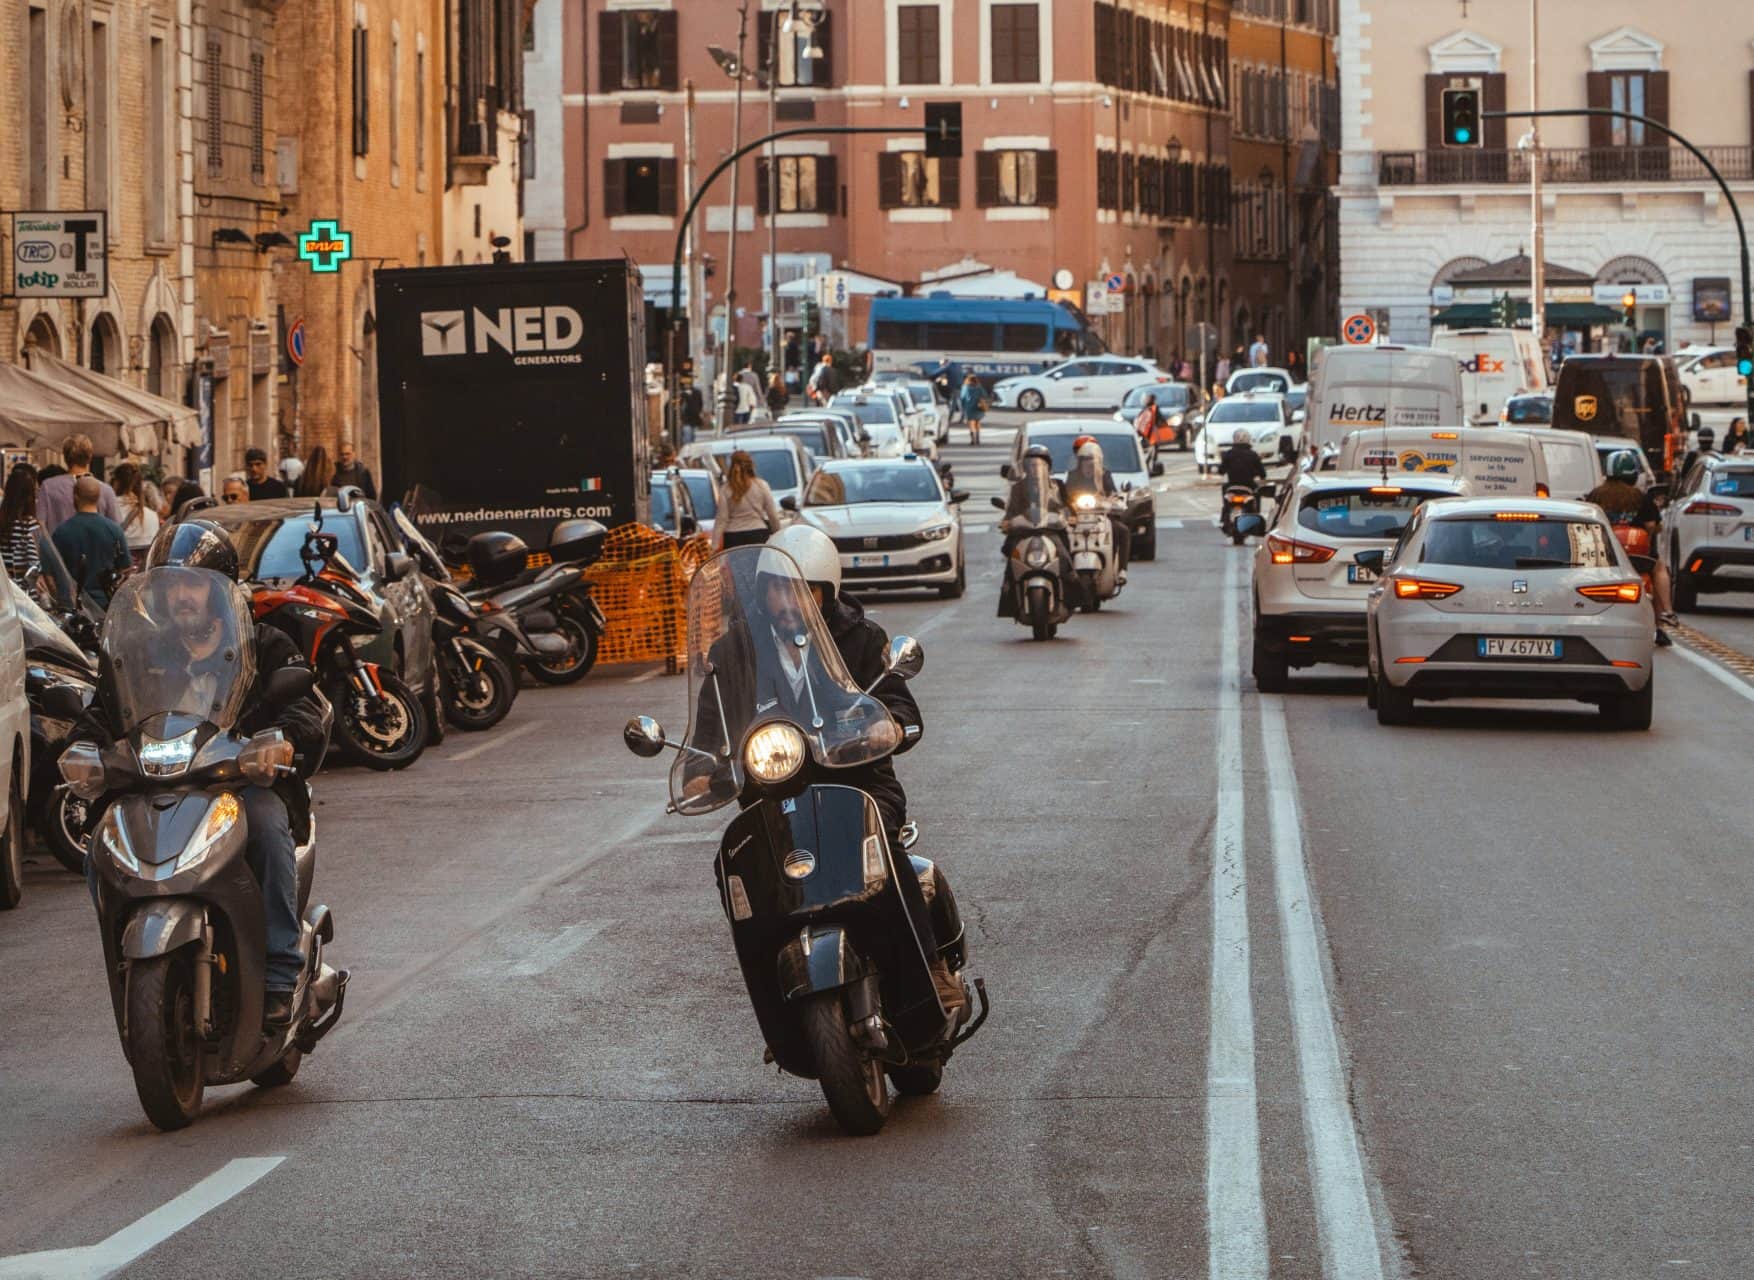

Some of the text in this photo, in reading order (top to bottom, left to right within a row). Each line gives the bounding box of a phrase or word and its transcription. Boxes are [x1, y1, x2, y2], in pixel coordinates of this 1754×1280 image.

[64, 220, 97, 272] T
[18, 271, 59, 289] totip
[473, 305, 583, 355] NED
[514, 354, 582, 365] GENERATORS
[1458, 354, 1504, 373] edEx
[1330, 403, 1385, 421] Hertz
[1488, 639, 1553, 655] FV 467VX
